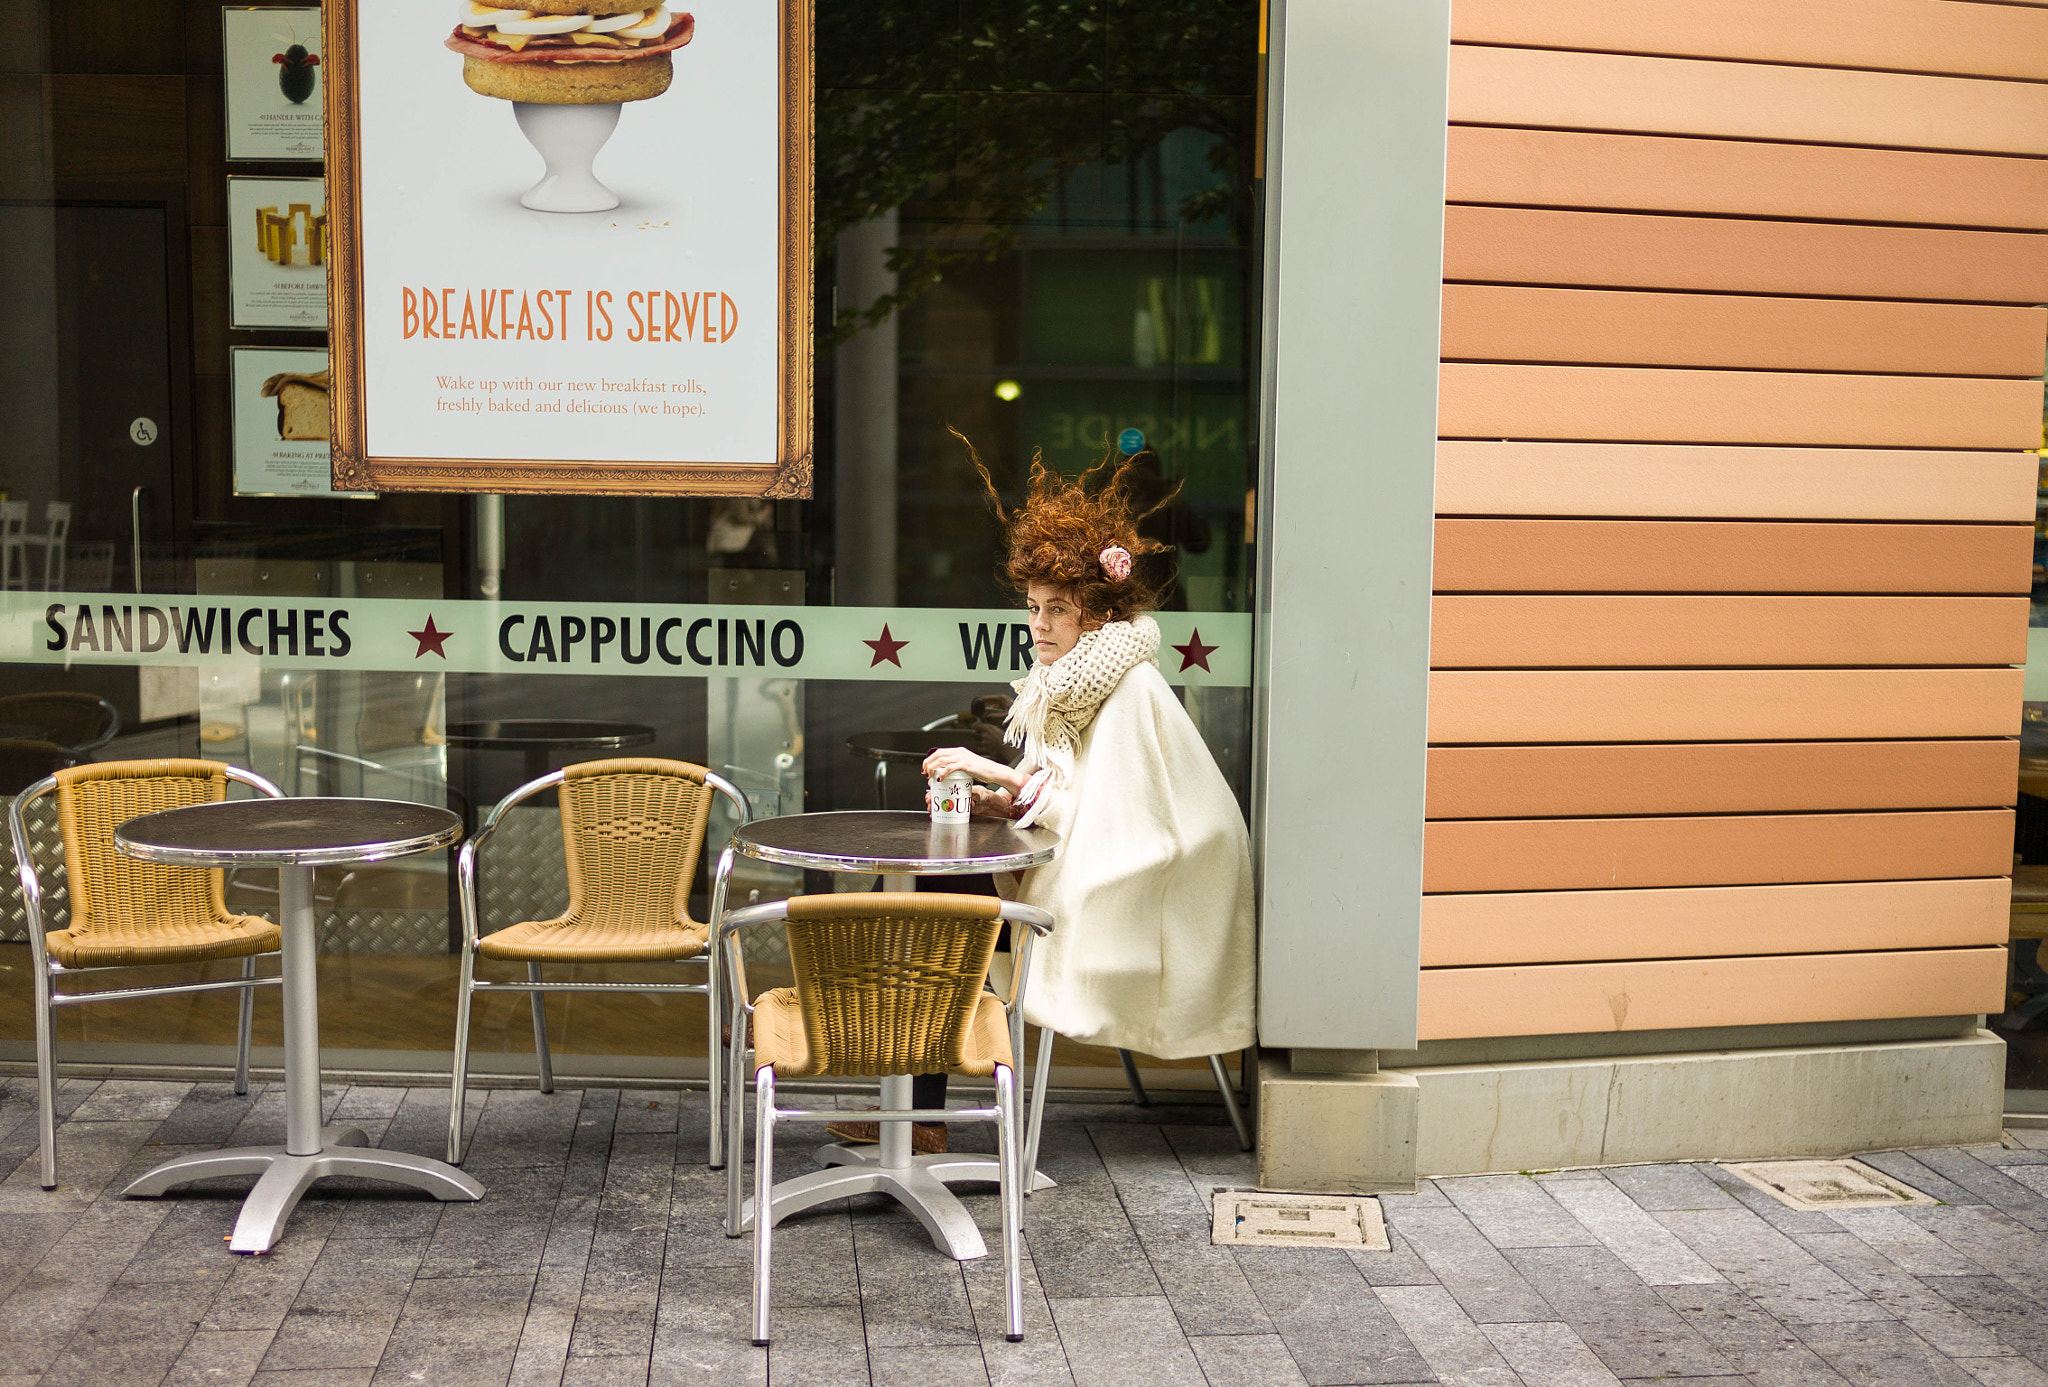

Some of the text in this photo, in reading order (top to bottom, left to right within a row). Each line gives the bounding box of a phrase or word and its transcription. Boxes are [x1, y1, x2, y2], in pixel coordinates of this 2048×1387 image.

[402, 286, 739, 344] BREAKFAST IS SERVED
[436, 376, 707, 396] Wake up with our new breakfast rolls,
[437, 397, 706, 418] freshly baked and delicious (we hope).
[46, 603, 352, 658] SANDWICHES
[499, 614, 805, 668] CAPPUCCINO
